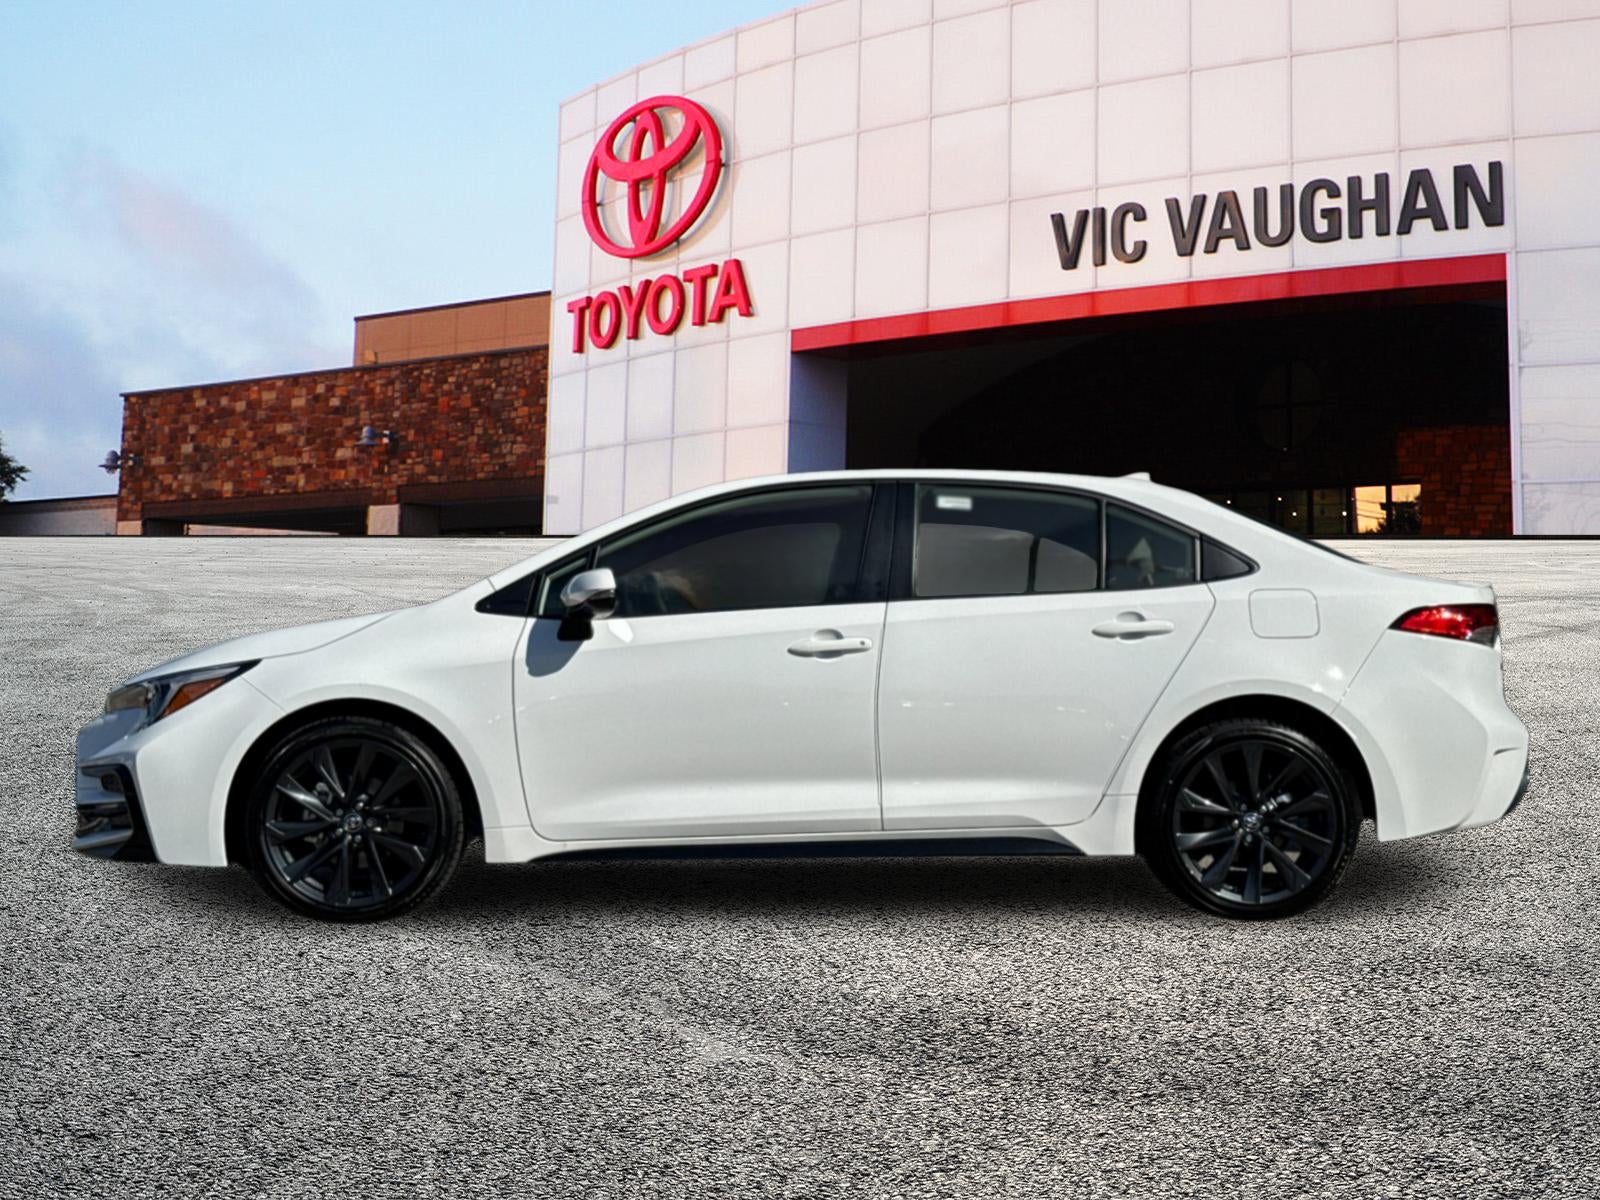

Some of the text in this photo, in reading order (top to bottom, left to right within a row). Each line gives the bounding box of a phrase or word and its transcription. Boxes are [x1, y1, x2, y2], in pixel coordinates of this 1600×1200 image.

[1050, 161, 1504, 270] VIC VAUGHAN
[567, 259, 753, 353] TOYOTA
